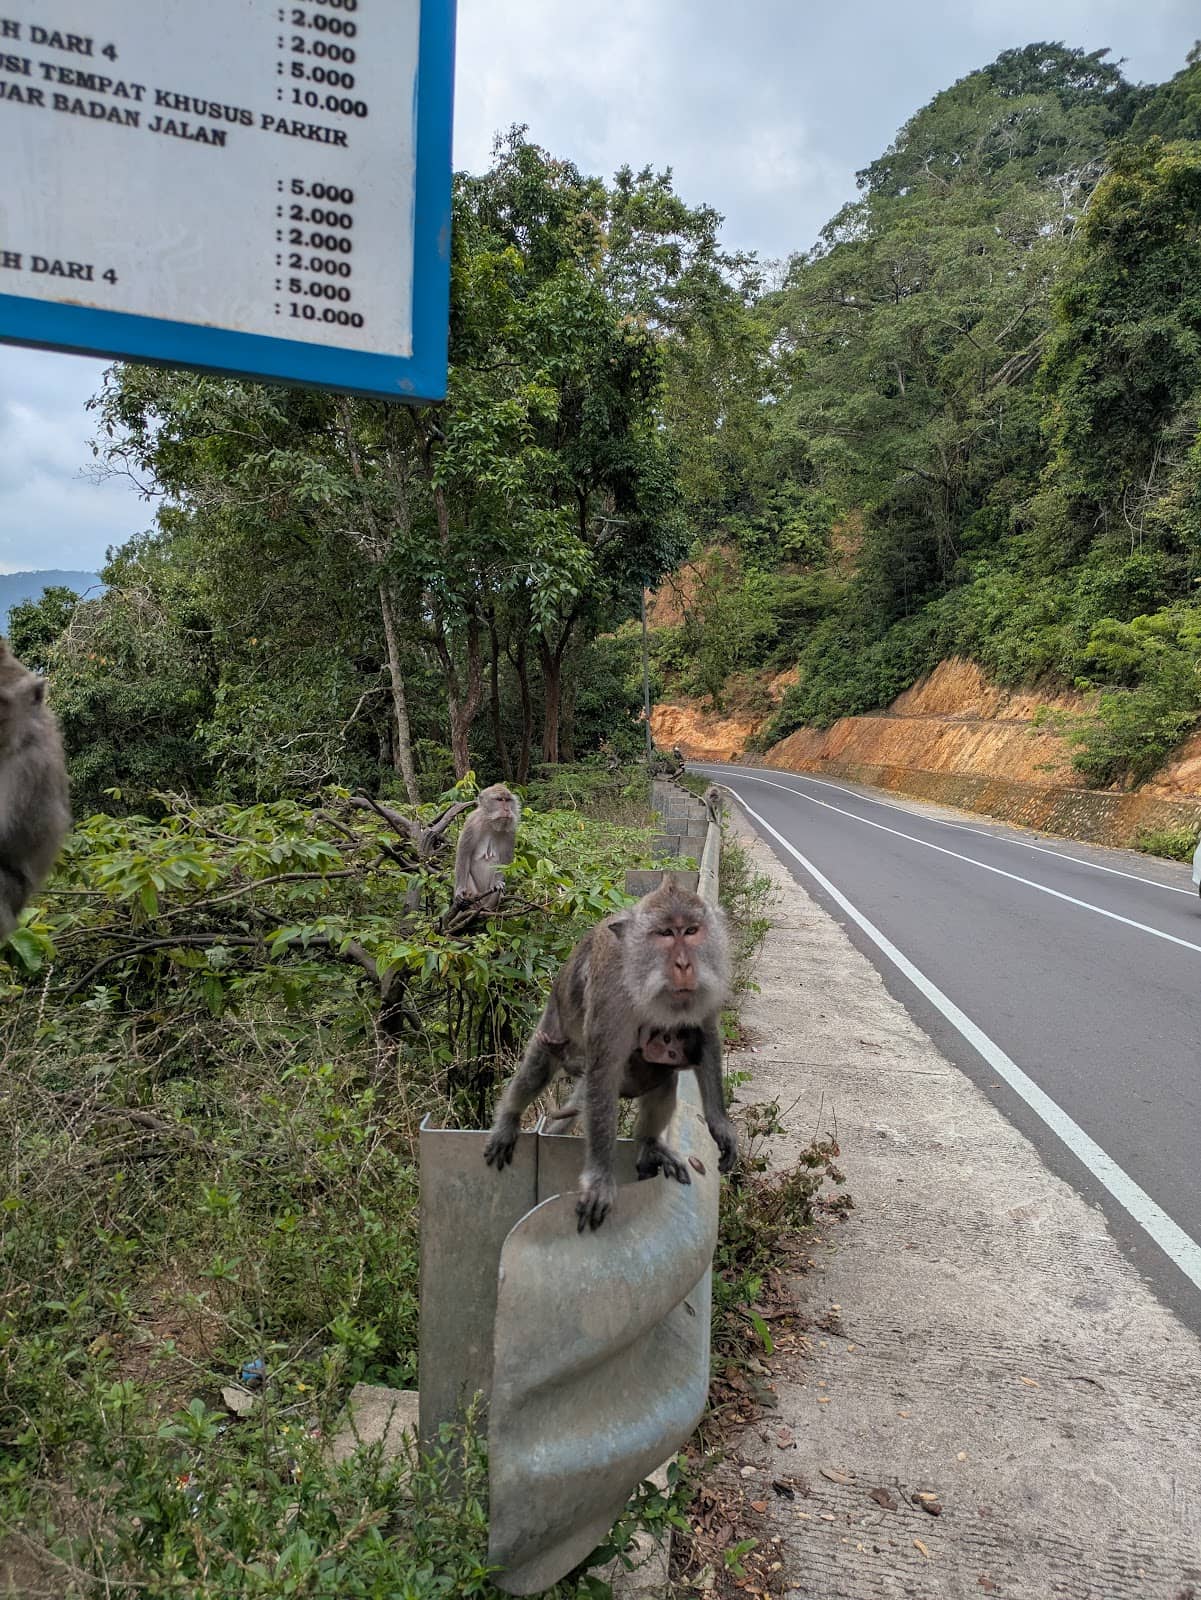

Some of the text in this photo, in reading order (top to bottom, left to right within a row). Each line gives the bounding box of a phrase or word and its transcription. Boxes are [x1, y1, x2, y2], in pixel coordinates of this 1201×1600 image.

[292, 9, 357, 38] 2.000
[30, 26, 93, 56] DARI
[102, 44, 119, 62] 4
[291, 36, 356, 64] 2.000
[291, 62, 355, 90] 5.000
[40, 62, 146, 101] TEMPAT
[155, 89, 254, 126] KHUSUS
[261, 114, 348, 147] PARKIR
[292, 88, 368, 118] 10.000
[53, 94, 140, 128] BADAN
[148, 116, 227, 147] JALAN
[291, 179, 354, 204] 5.000
[290, 204, 353, 229] 2.000
[289, 228, 352, 254] 2.000
[31, 256, 93, 281] DARI
[102, 269, 118, 285] 4
[289, 253, 351, 278] 2.000
[289, 278, 351, 302] 5.000
[290, 303, 364, 328] 10.000
